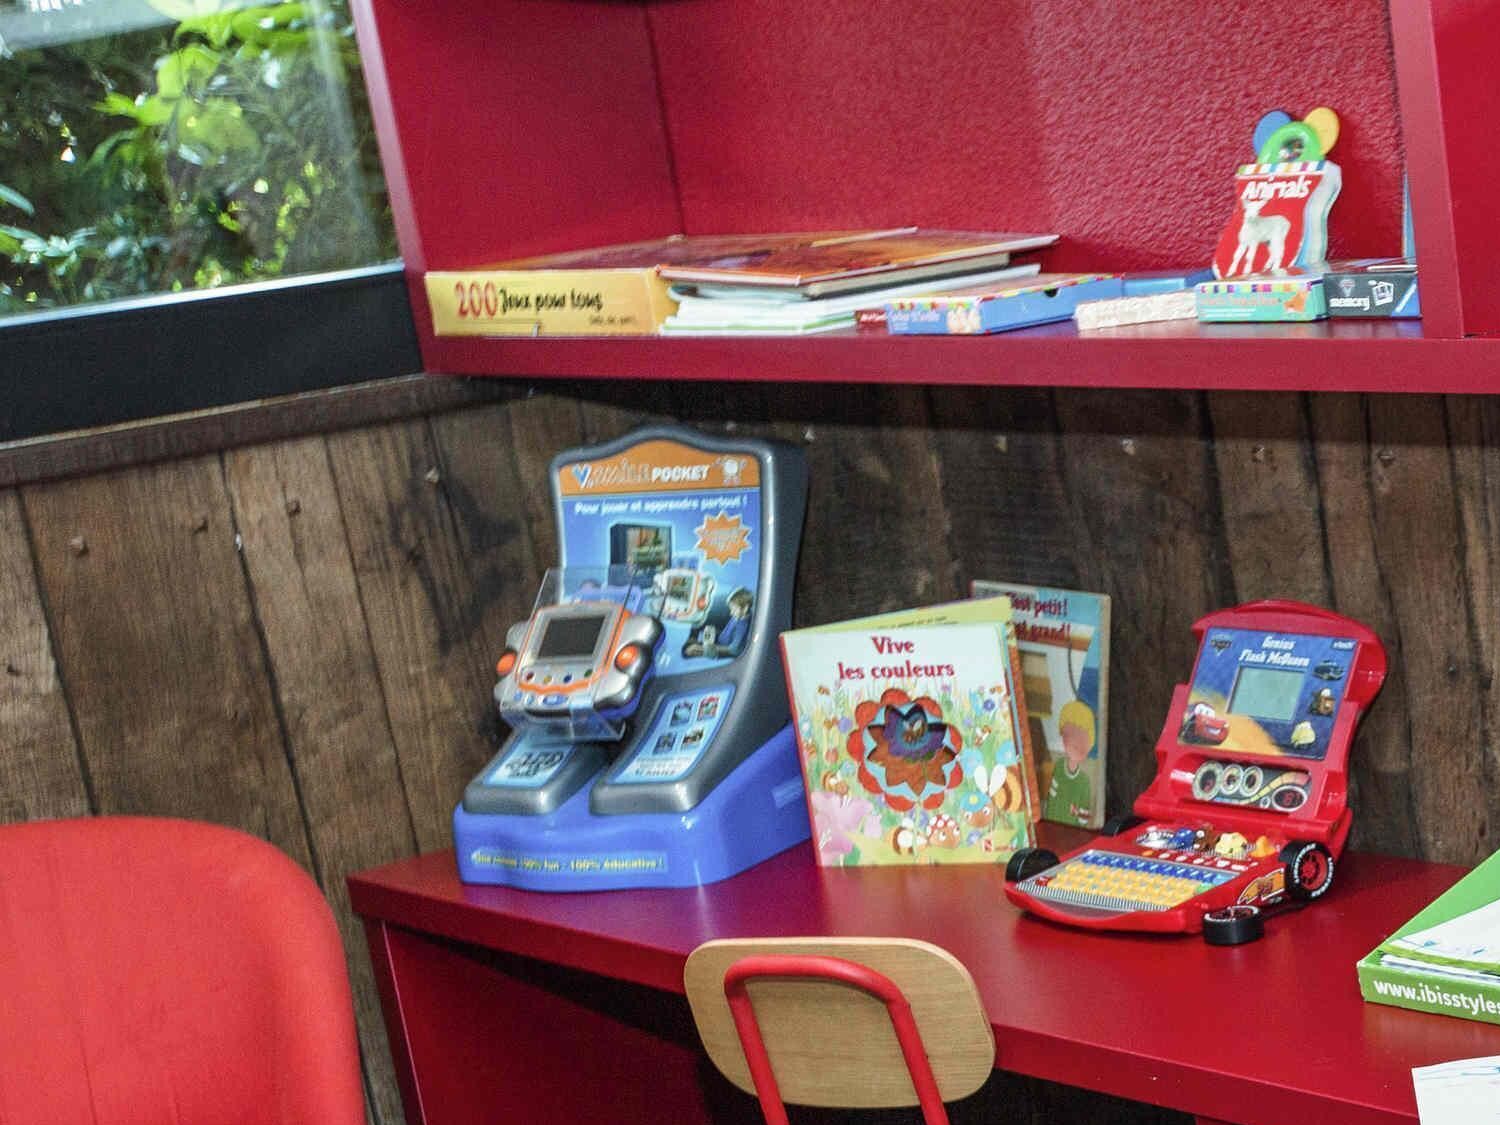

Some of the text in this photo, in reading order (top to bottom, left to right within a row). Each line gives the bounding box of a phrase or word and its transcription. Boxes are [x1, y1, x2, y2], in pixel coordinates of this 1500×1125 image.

[1240, 175, 1313, 199] Animals
[455, 281, 498, 318] 200
[499, 288, 532, 314] Jeux
[535, 292, 565, 312] pour
[651, 464, 710, 484] POCKET
[574, 502, 600, 516] Pour
[871, 636, 916, 655] Vive
[1262, 635, 1297, 651] Genius
[1238, 648, 1311, 668] Flash McQueen
[837, 659, 956, 682] les couleurs
